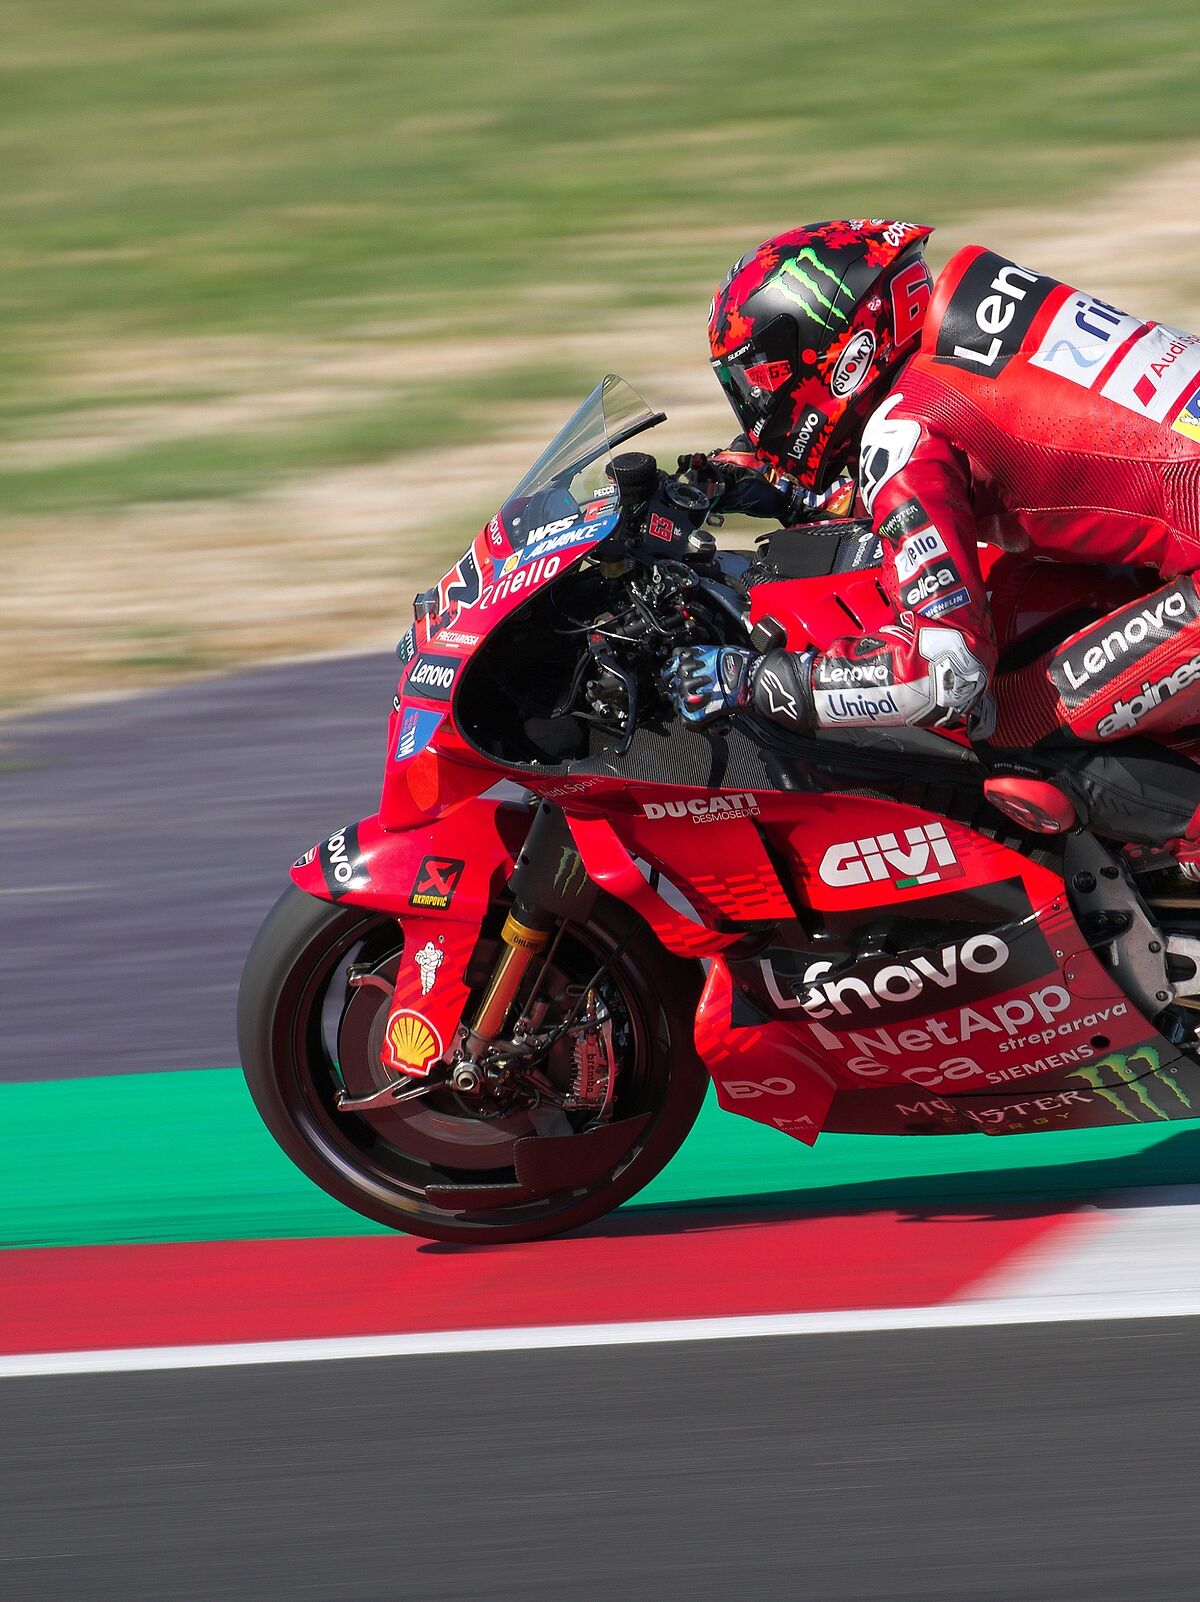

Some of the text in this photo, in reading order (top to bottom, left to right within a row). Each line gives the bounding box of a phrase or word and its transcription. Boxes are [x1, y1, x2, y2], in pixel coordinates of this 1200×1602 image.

[953, 265, 1048, 367] Len
[834, 337, 876, 390] SUOMY
[1150, 334, 1188, 379] Audi
[786, 411, 820, 461] Lenovo
[593, 485, 616, 498] PECCO
[526, 513, 580, 547] WRS
[491, 556, 561, 605] riello
[1062, 590, 1187, 691] Lenovo
[409, 658, 455, 688] Lenovo
[819, 662, 889, 684] Lenovo
[825, 689, 900, 722] Unipol
[564, 777, 605, 793] Sport
[642, 792, 759, 820] DUCATI
[692, 806, 761, 824] DESMOSEDICI
[818, 821, 957, 888] GIVI
[759, 933, 1010, 1020] Lenovo
[848, 985, 1071, 1059] NetApp
[998, 1001, 1129, 1053] streparava
[985, 1043, 1095, 1085] SIEMENS
